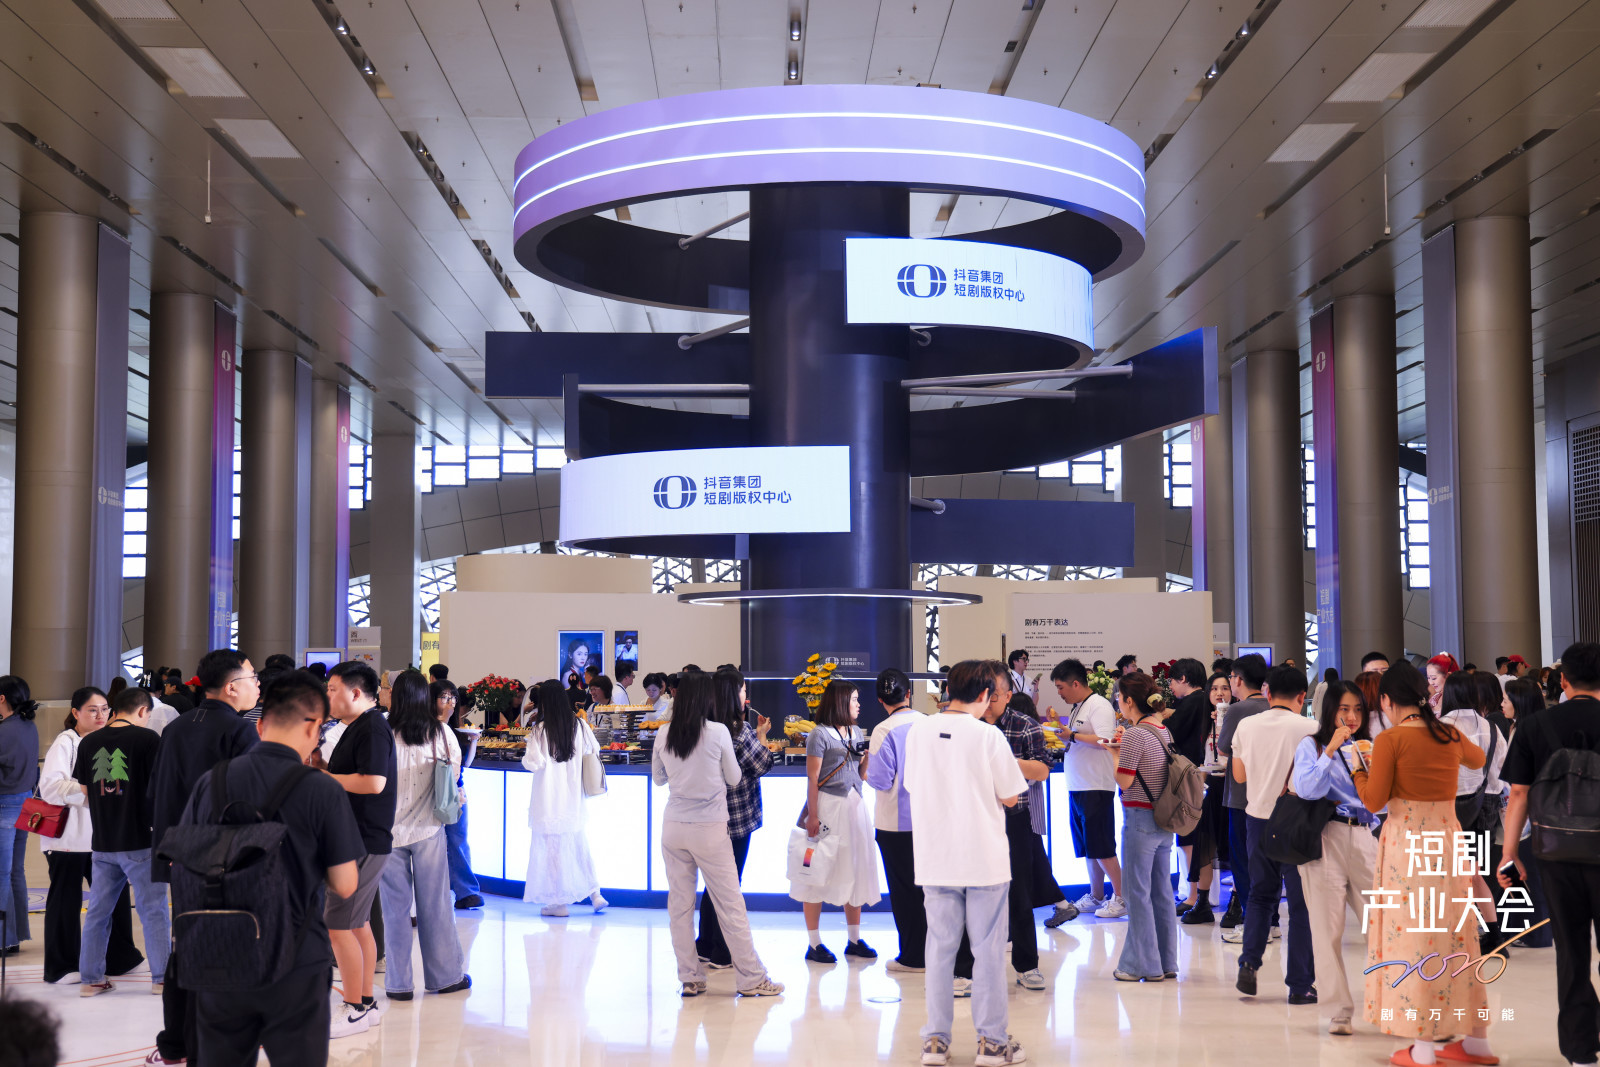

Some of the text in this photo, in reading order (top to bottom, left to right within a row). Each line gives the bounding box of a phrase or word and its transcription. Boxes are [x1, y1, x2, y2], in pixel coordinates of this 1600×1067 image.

[953, 268, 1004, 285] 抖音集团
[953, 283, 1026, 302] 短剧版权中心
[703, 475, 762, 490] 抖音集团
[703, 490, 792, 506] 短剧版权中心
